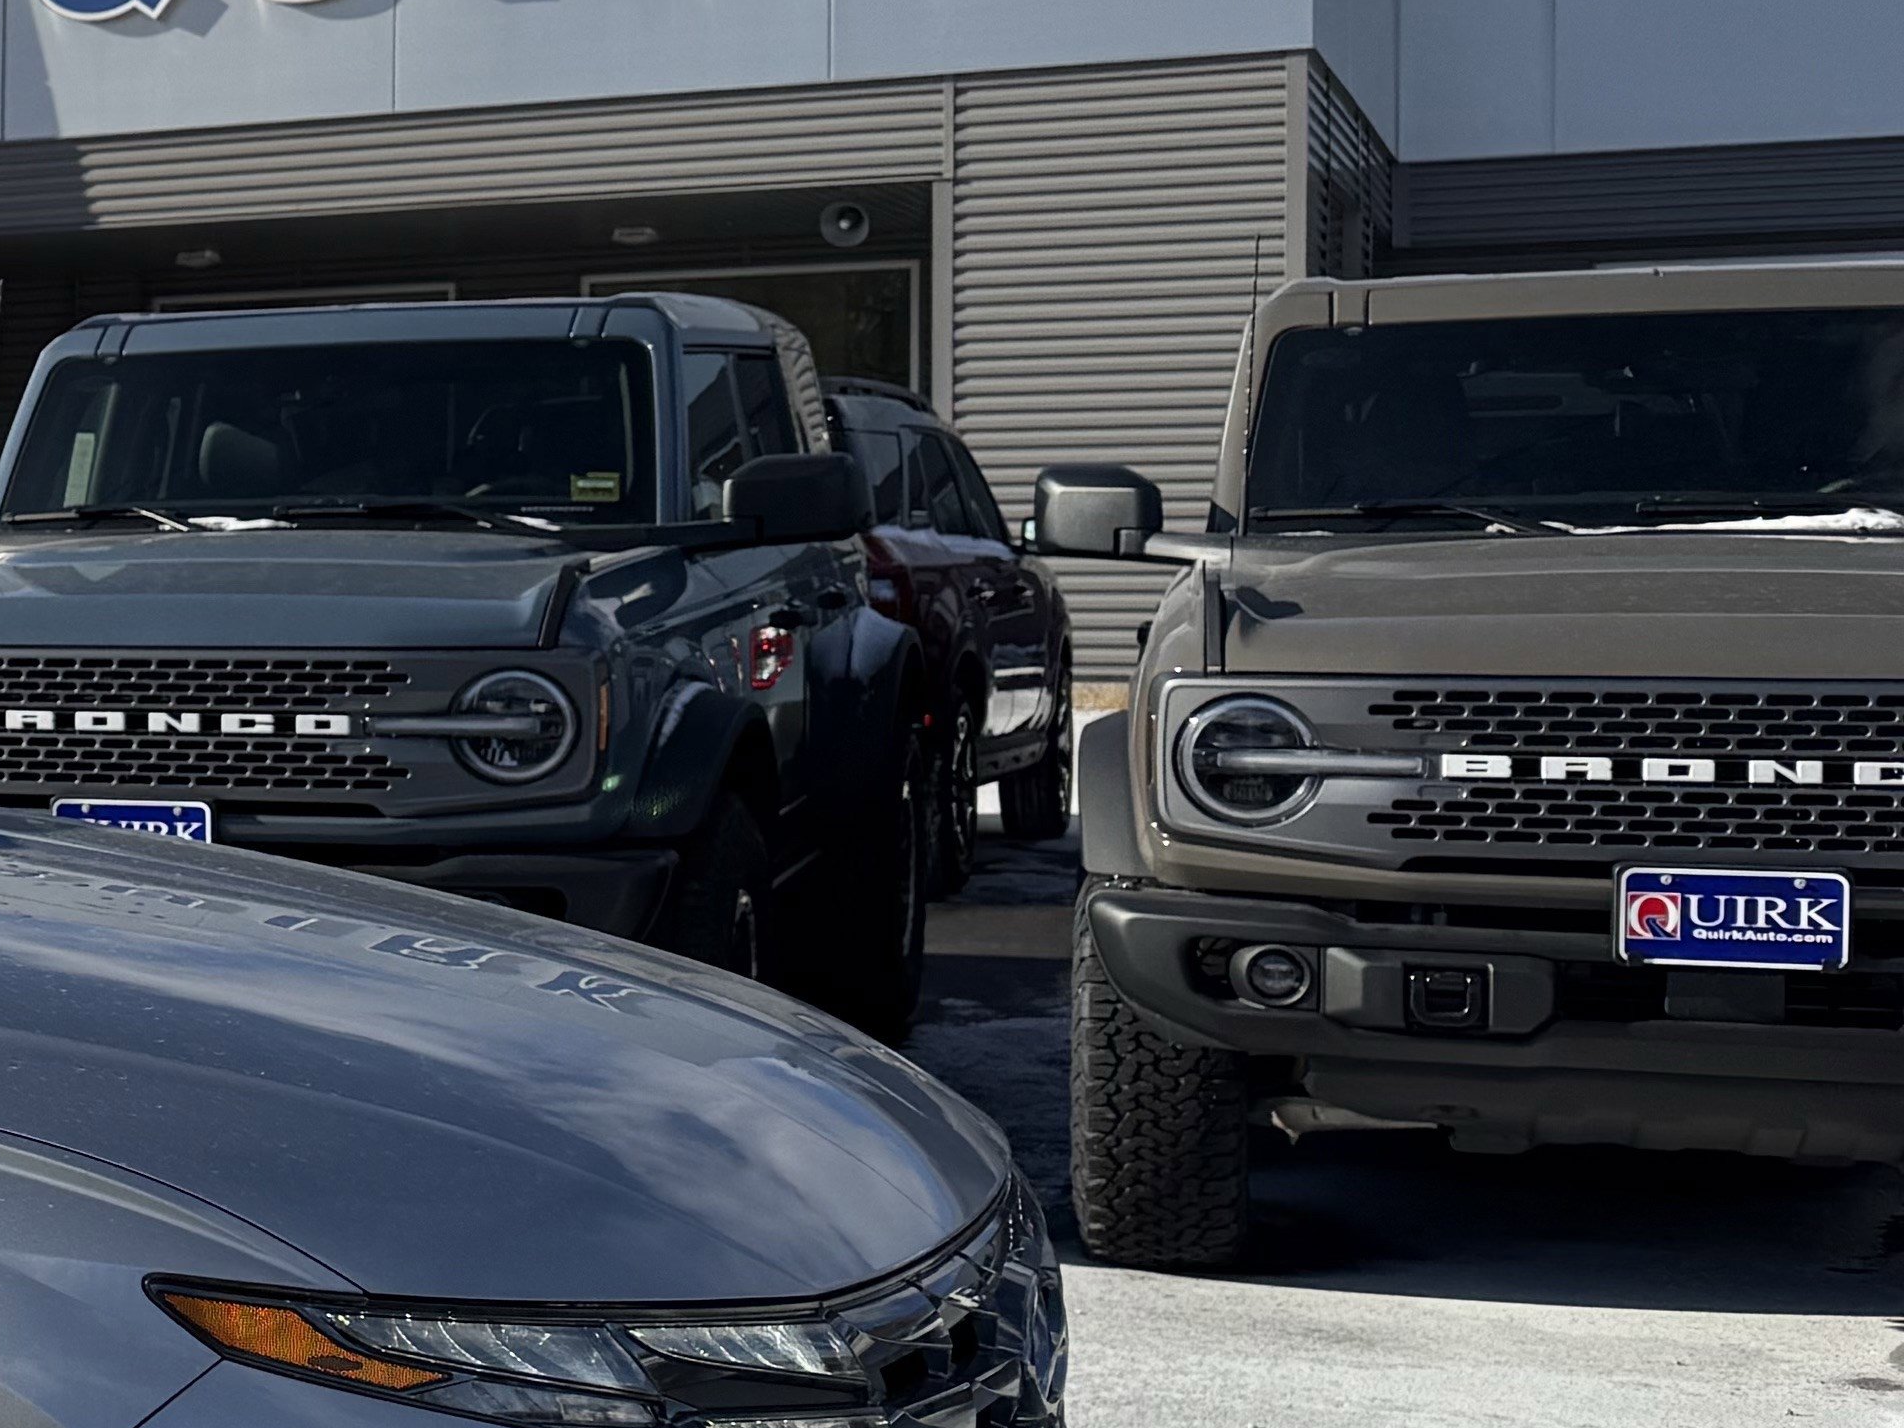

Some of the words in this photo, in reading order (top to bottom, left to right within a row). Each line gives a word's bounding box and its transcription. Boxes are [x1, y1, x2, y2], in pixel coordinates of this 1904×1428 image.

[1442, 754, 1904, 786] BRONC
[1628, 892, 1842, 940] QUIRK
[1692, 928, 1834, 944] QuirkAuto.com
